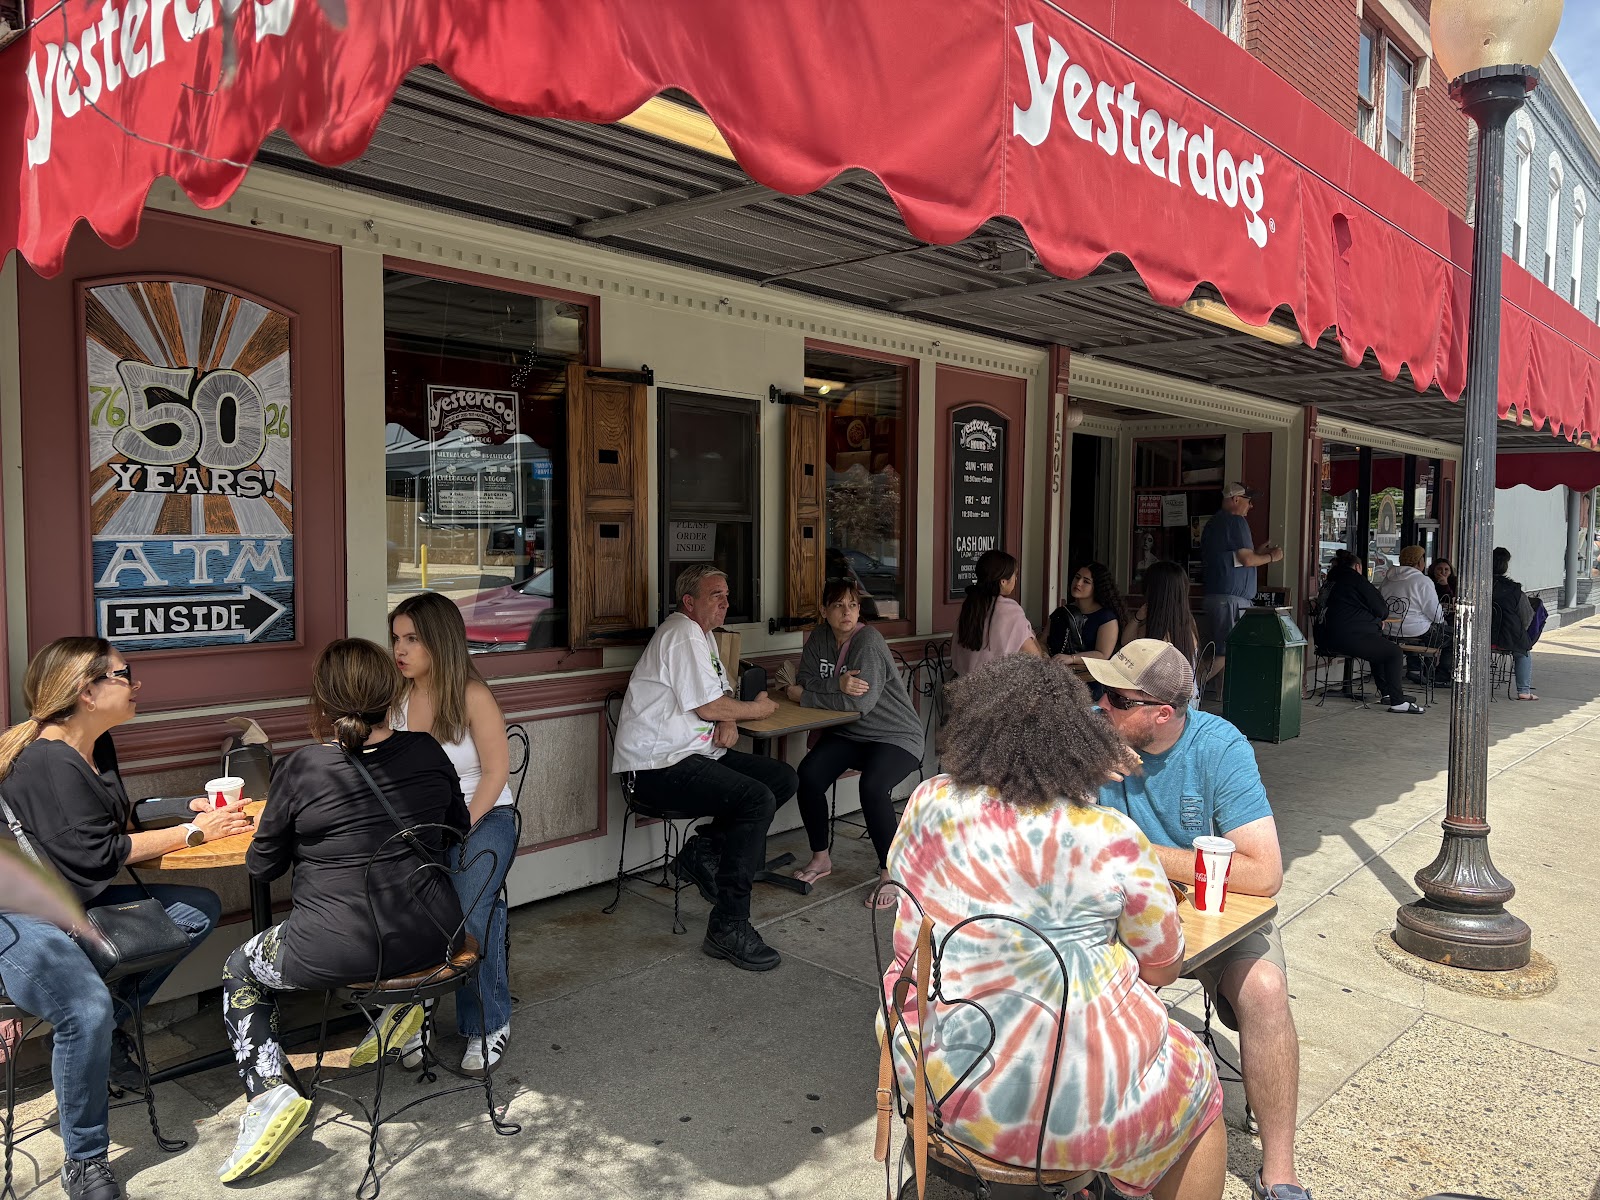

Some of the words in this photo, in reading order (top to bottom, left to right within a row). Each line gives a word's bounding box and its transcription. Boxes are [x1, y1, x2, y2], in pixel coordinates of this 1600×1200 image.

[89, 385, 125, 428] 76
[112, 359, 267, 470] 50
[265, 403, 290, 438] 26
[970, 440, 986, 450] HOURS
[1052, 412, 1061, 493] 1505
[108, 463, 277, 498] YEARS!
[676, 521, 709, 529] PLEASE
[676, 532, 707, 540] ORDER
[676, 543, 706, 552] INSIDE
[956, 536, 977, 551] CASH
[977, 536, 995, 551] ONLY
[94, 540, 292, 587] ATM
[115, 604, 246, 634] INSIDE
